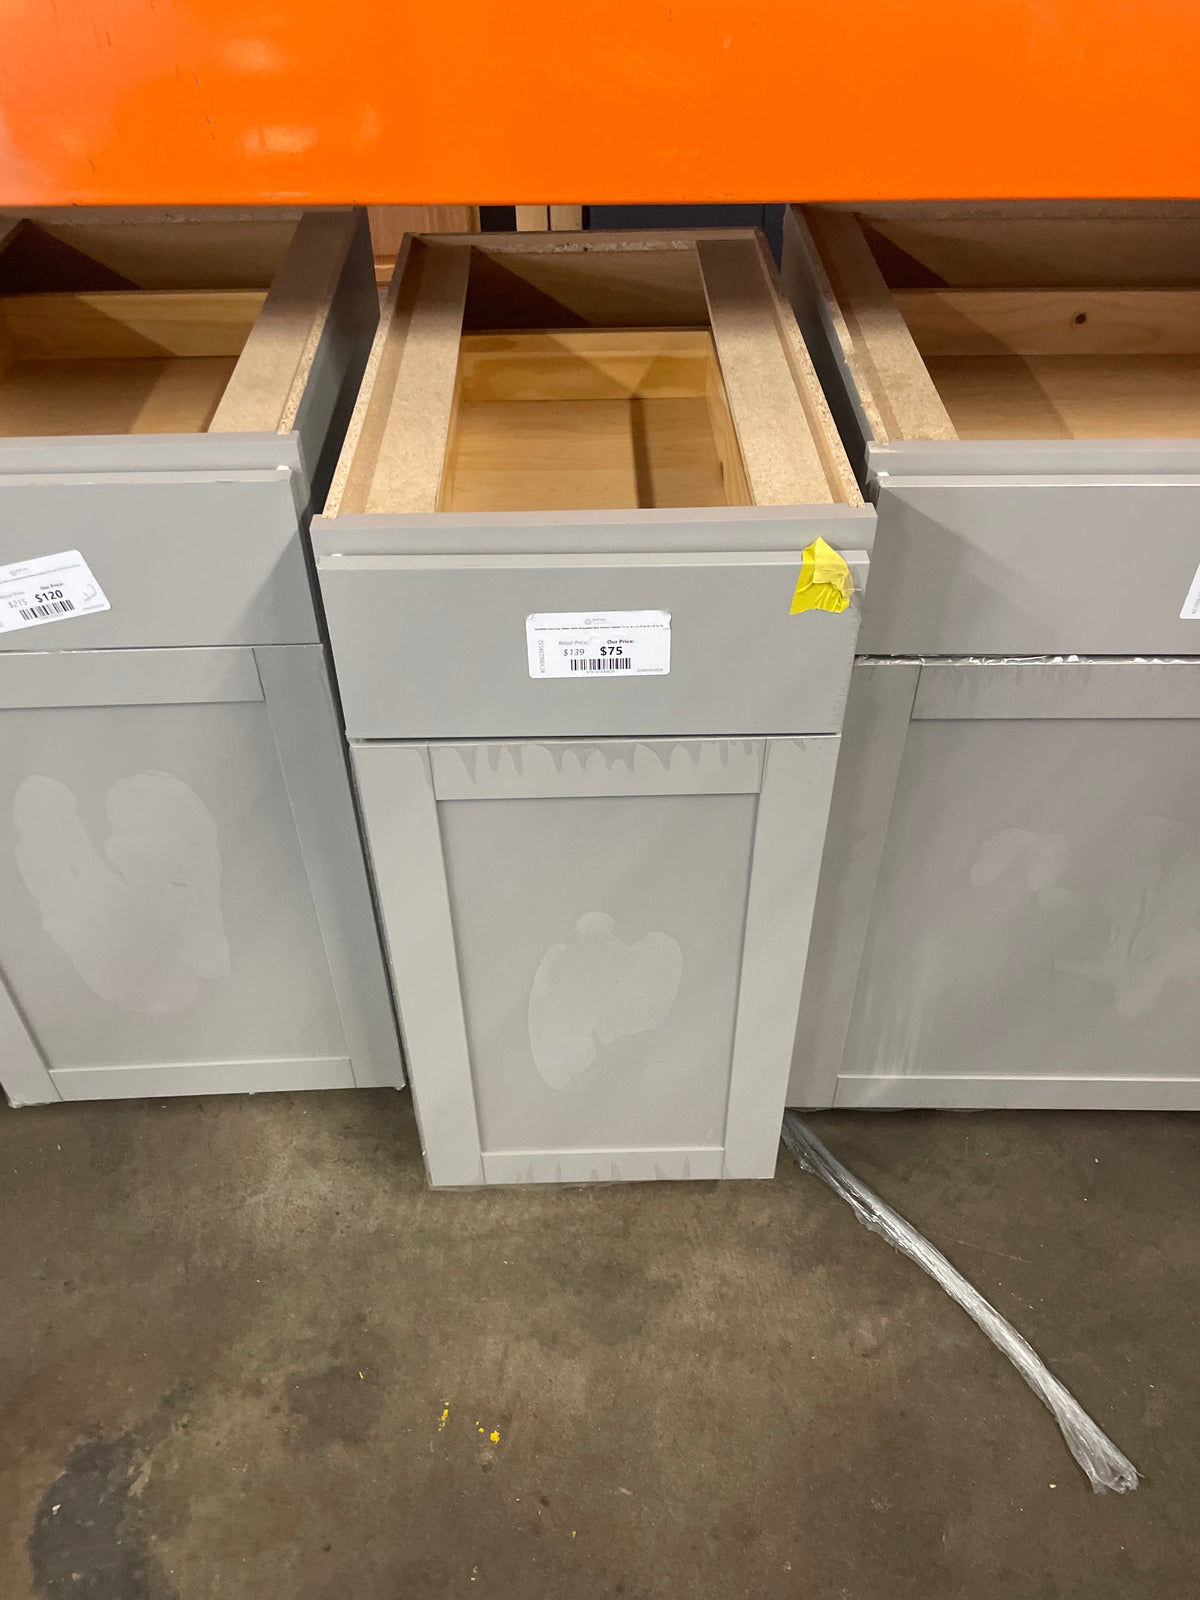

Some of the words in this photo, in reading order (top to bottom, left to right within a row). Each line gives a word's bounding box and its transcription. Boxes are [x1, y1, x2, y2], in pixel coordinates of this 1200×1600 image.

[35, 589, 64, 603] $120
[563, 648, 585, 657] $139
[599, 645, 623, 657] $75
